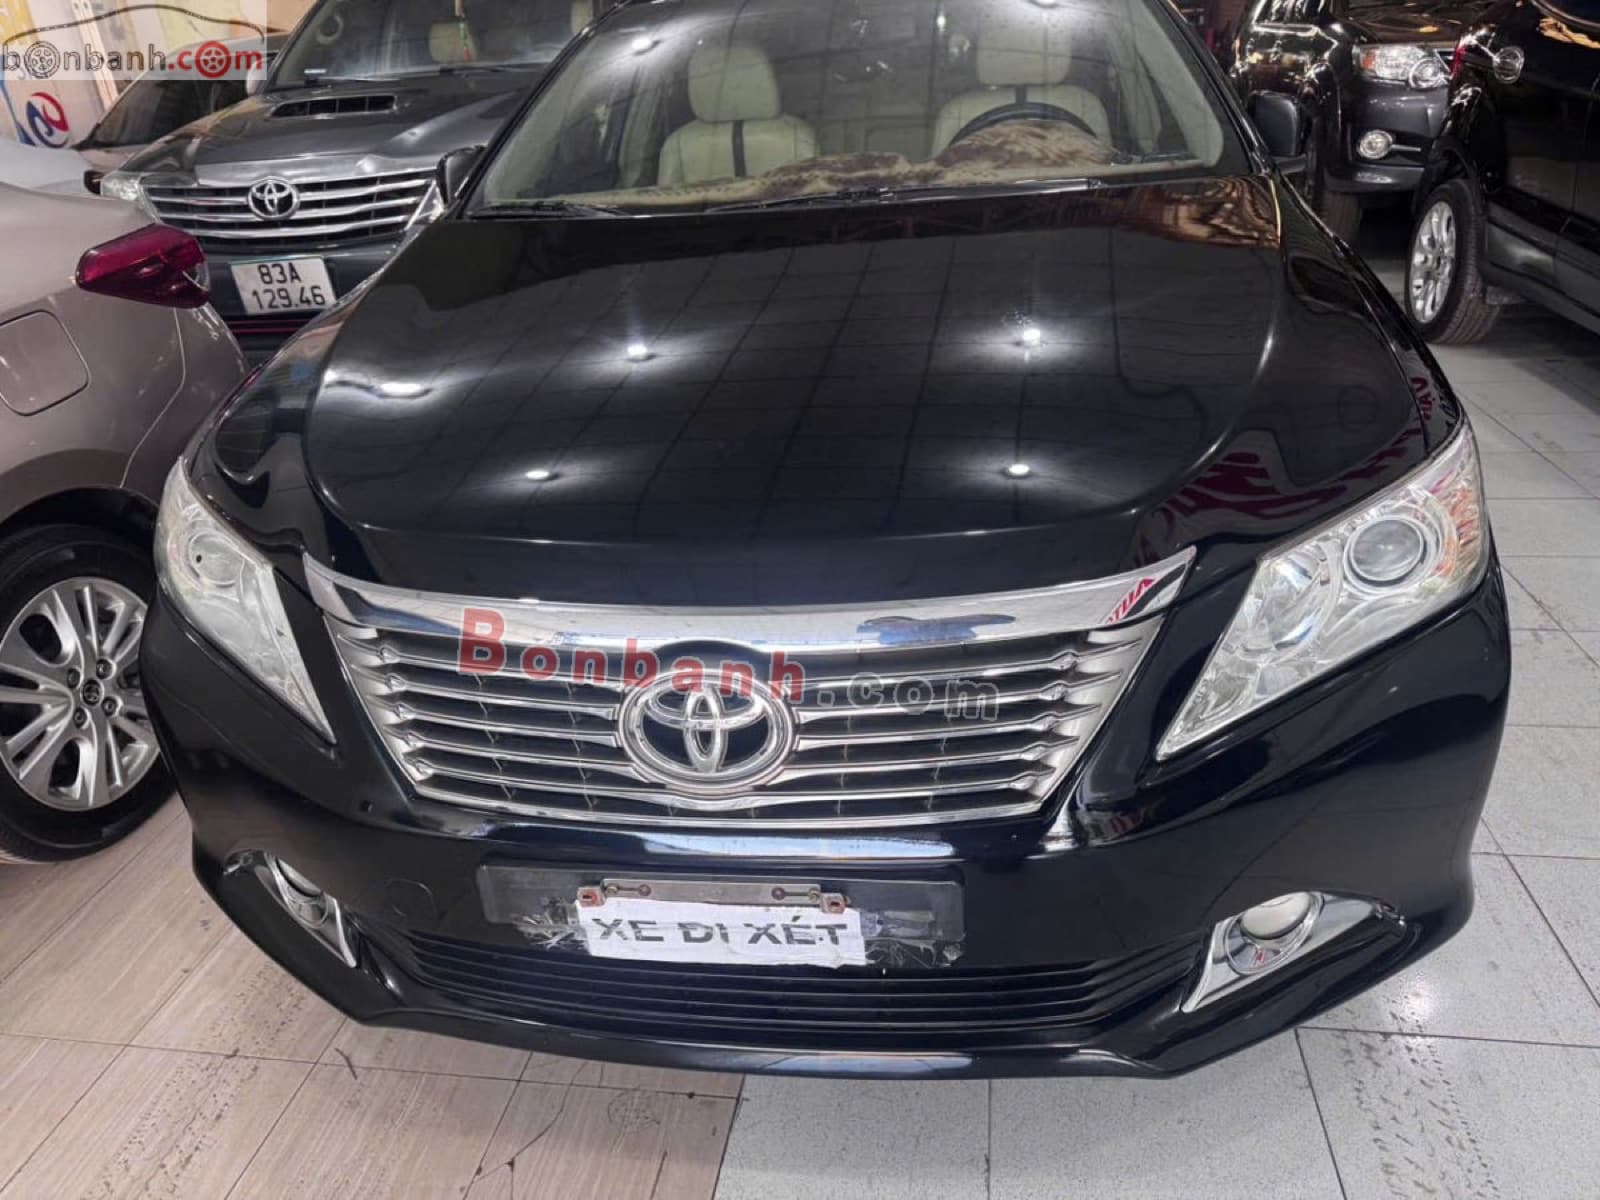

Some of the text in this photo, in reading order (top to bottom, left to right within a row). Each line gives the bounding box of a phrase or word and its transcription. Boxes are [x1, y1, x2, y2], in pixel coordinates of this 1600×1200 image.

[257, 262, 301, 284] 83A
[252, 286, 325, 310] 129.46
[592, 918, 664, 942] XE
[744, 916, 847, 945] XÉT
